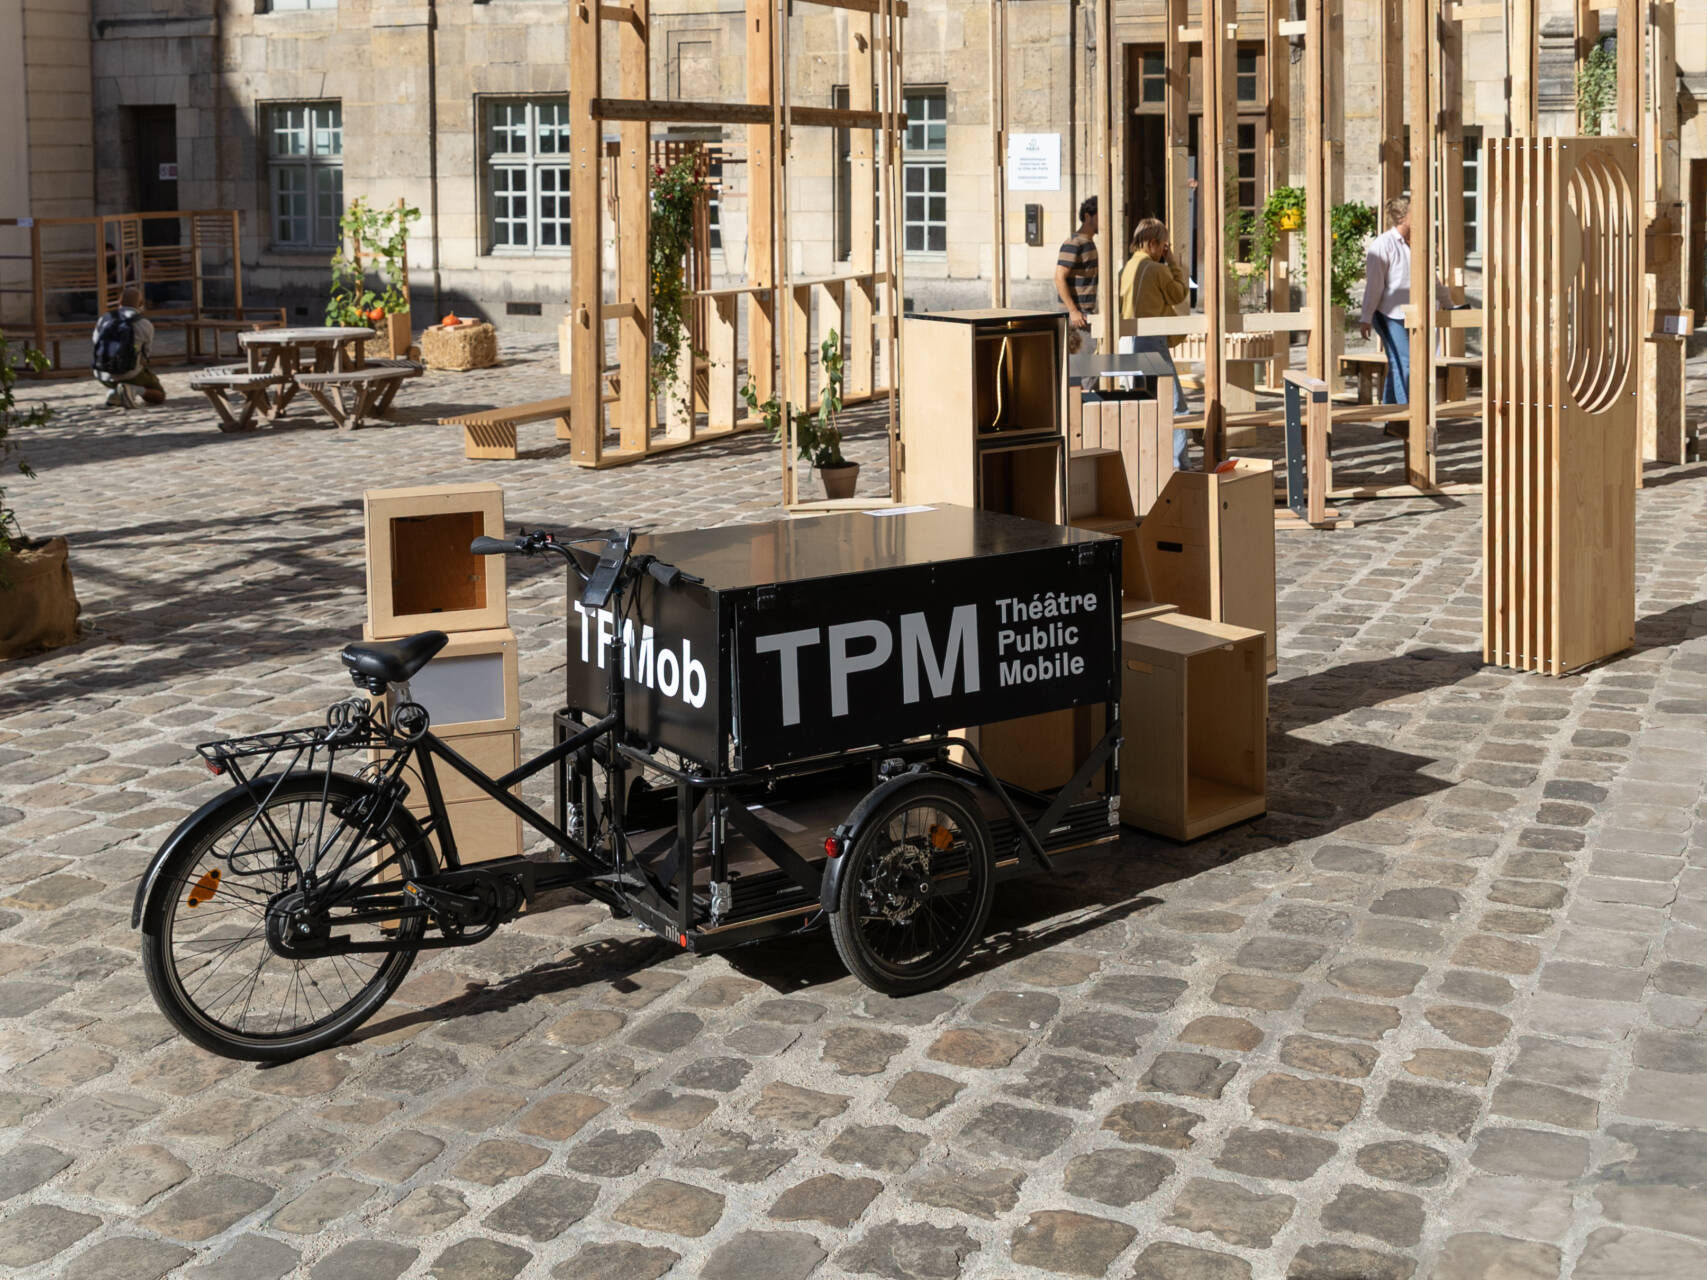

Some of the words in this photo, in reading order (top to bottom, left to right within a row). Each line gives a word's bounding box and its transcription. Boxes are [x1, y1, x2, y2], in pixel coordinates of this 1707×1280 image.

[995, 590, 1097, 624] Théâtre
[998, 621, 1079, 656] Public
[755, 603, 981, 727] TPM
[999, 651, 1085, 687] Mobile
